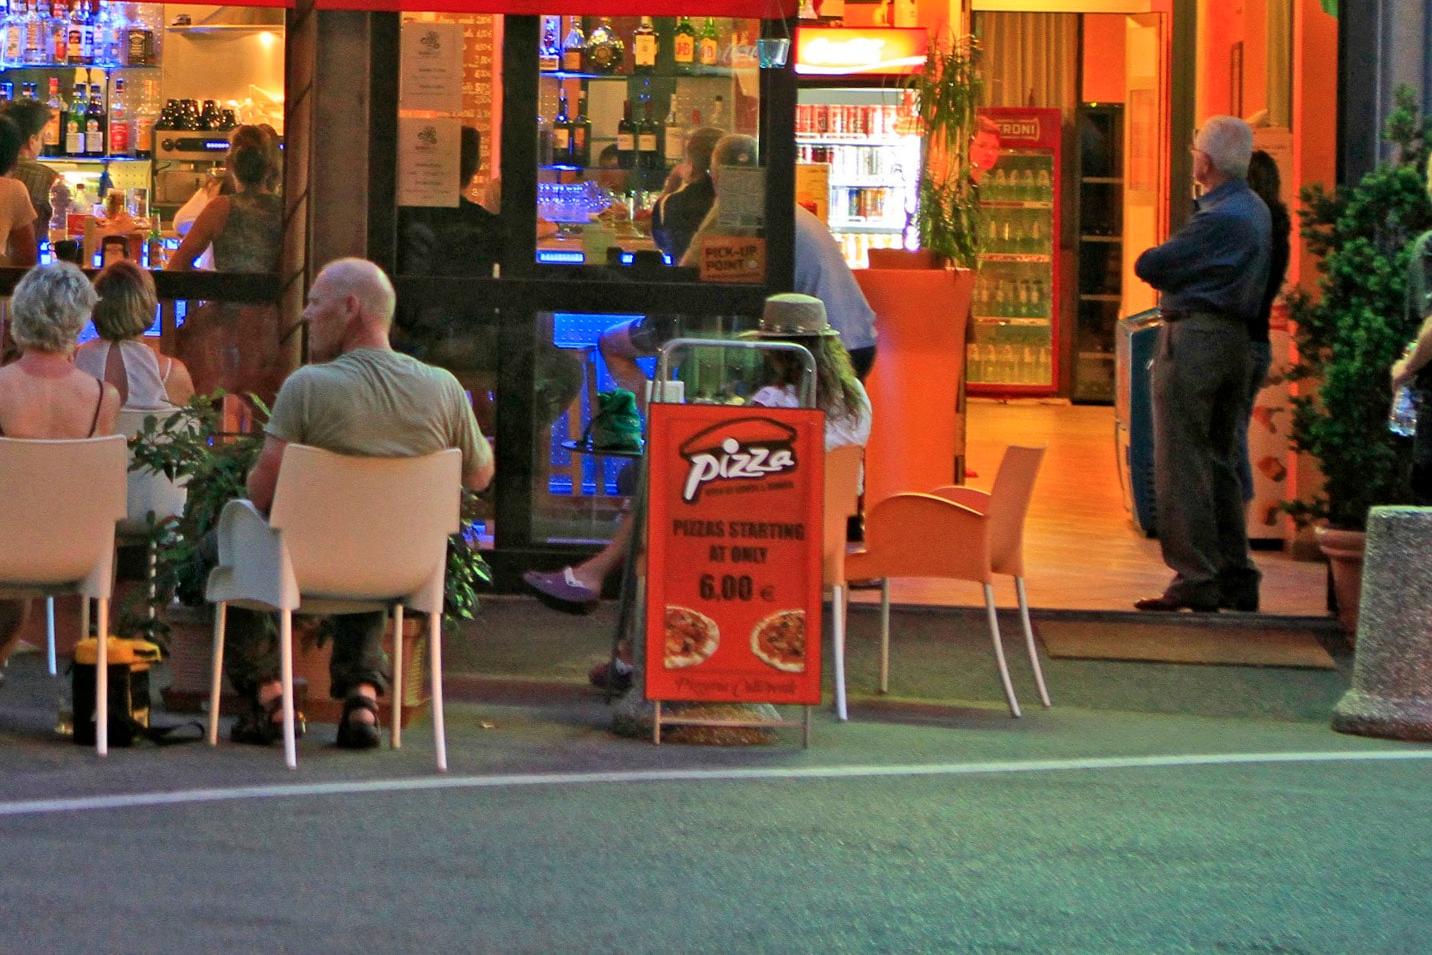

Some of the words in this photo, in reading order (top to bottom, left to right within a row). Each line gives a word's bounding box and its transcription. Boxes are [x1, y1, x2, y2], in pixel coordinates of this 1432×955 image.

[997, 123, 1036, 134] RONI
[705, 245, 757, 258] PICK-UP
[705, 258, 744, 271] POINT
[683, 437, 795, 500] pizza
[672, 518, 725, 538] PIZZAS
[729, 520, 806, 541] STARTING
[710, 545, 726, 563] AT
[731, 546, 768, 564] ONLY
